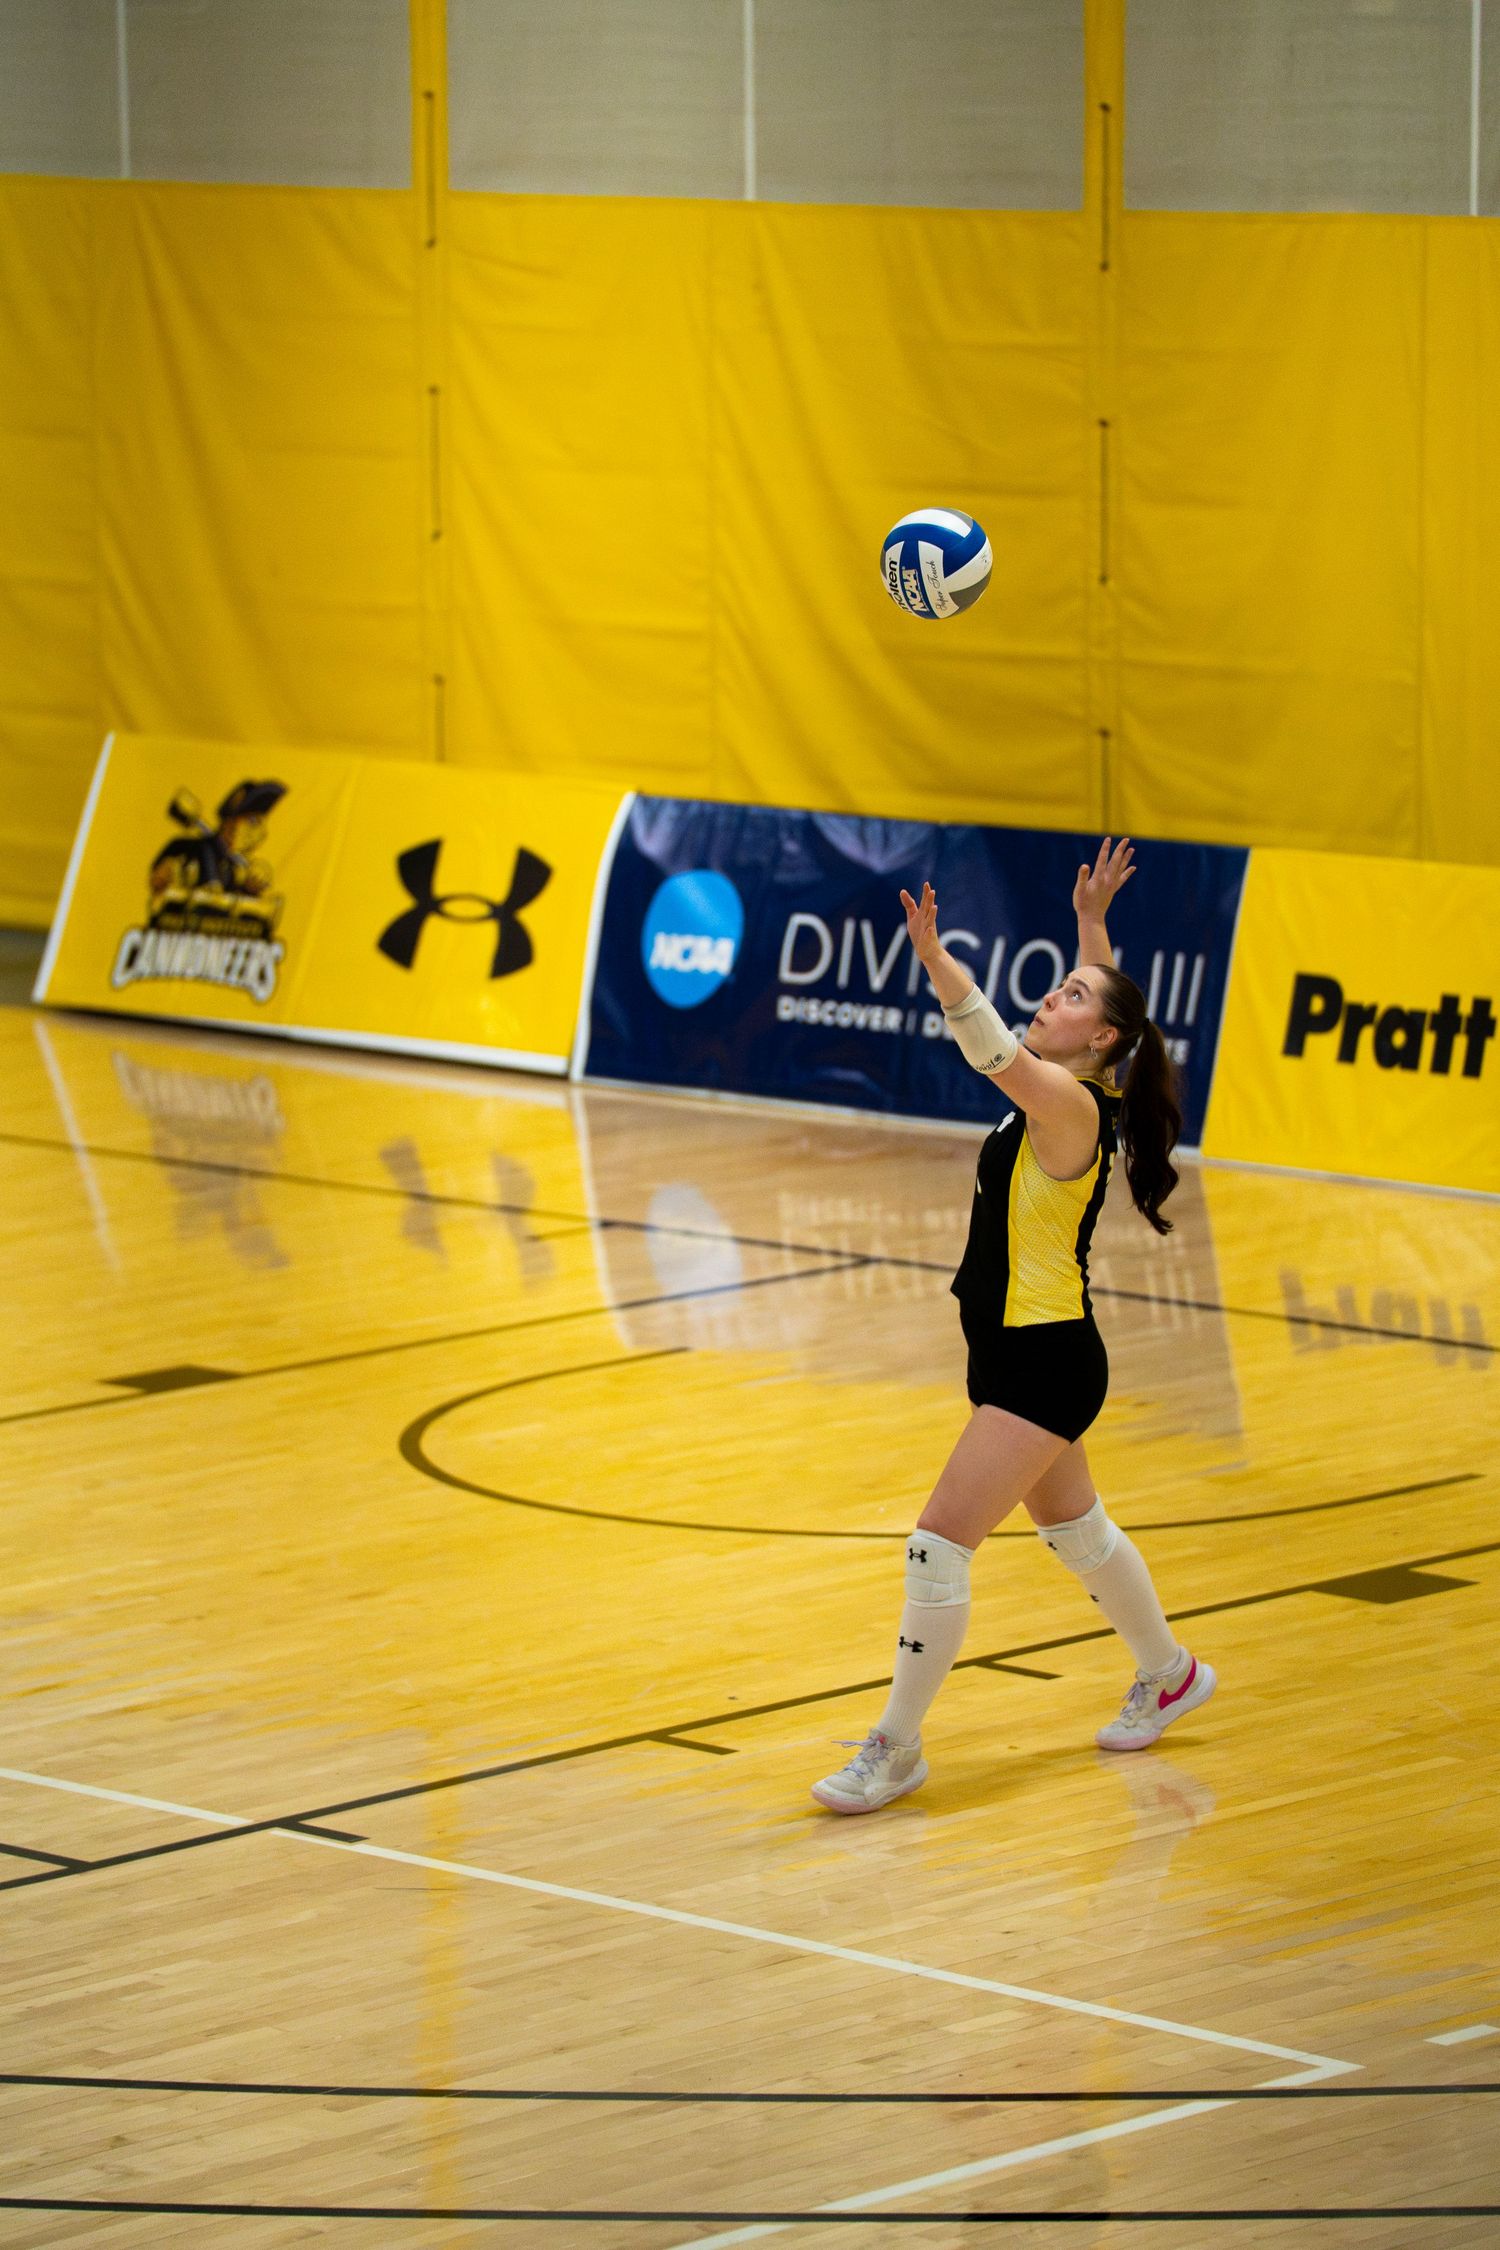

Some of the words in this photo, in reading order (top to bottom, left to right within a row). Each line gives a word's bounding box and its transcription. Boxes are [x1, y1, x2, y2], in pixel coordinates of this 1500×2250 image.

[902, 568, 930, 612] NCAA
[650, 931, 735, 977] NCAA
[1146, 949, 1206, 1027] III
[776, 995, 903, 1034] DISCOVER
[1282, 971, 1498, 1080] Pratt
